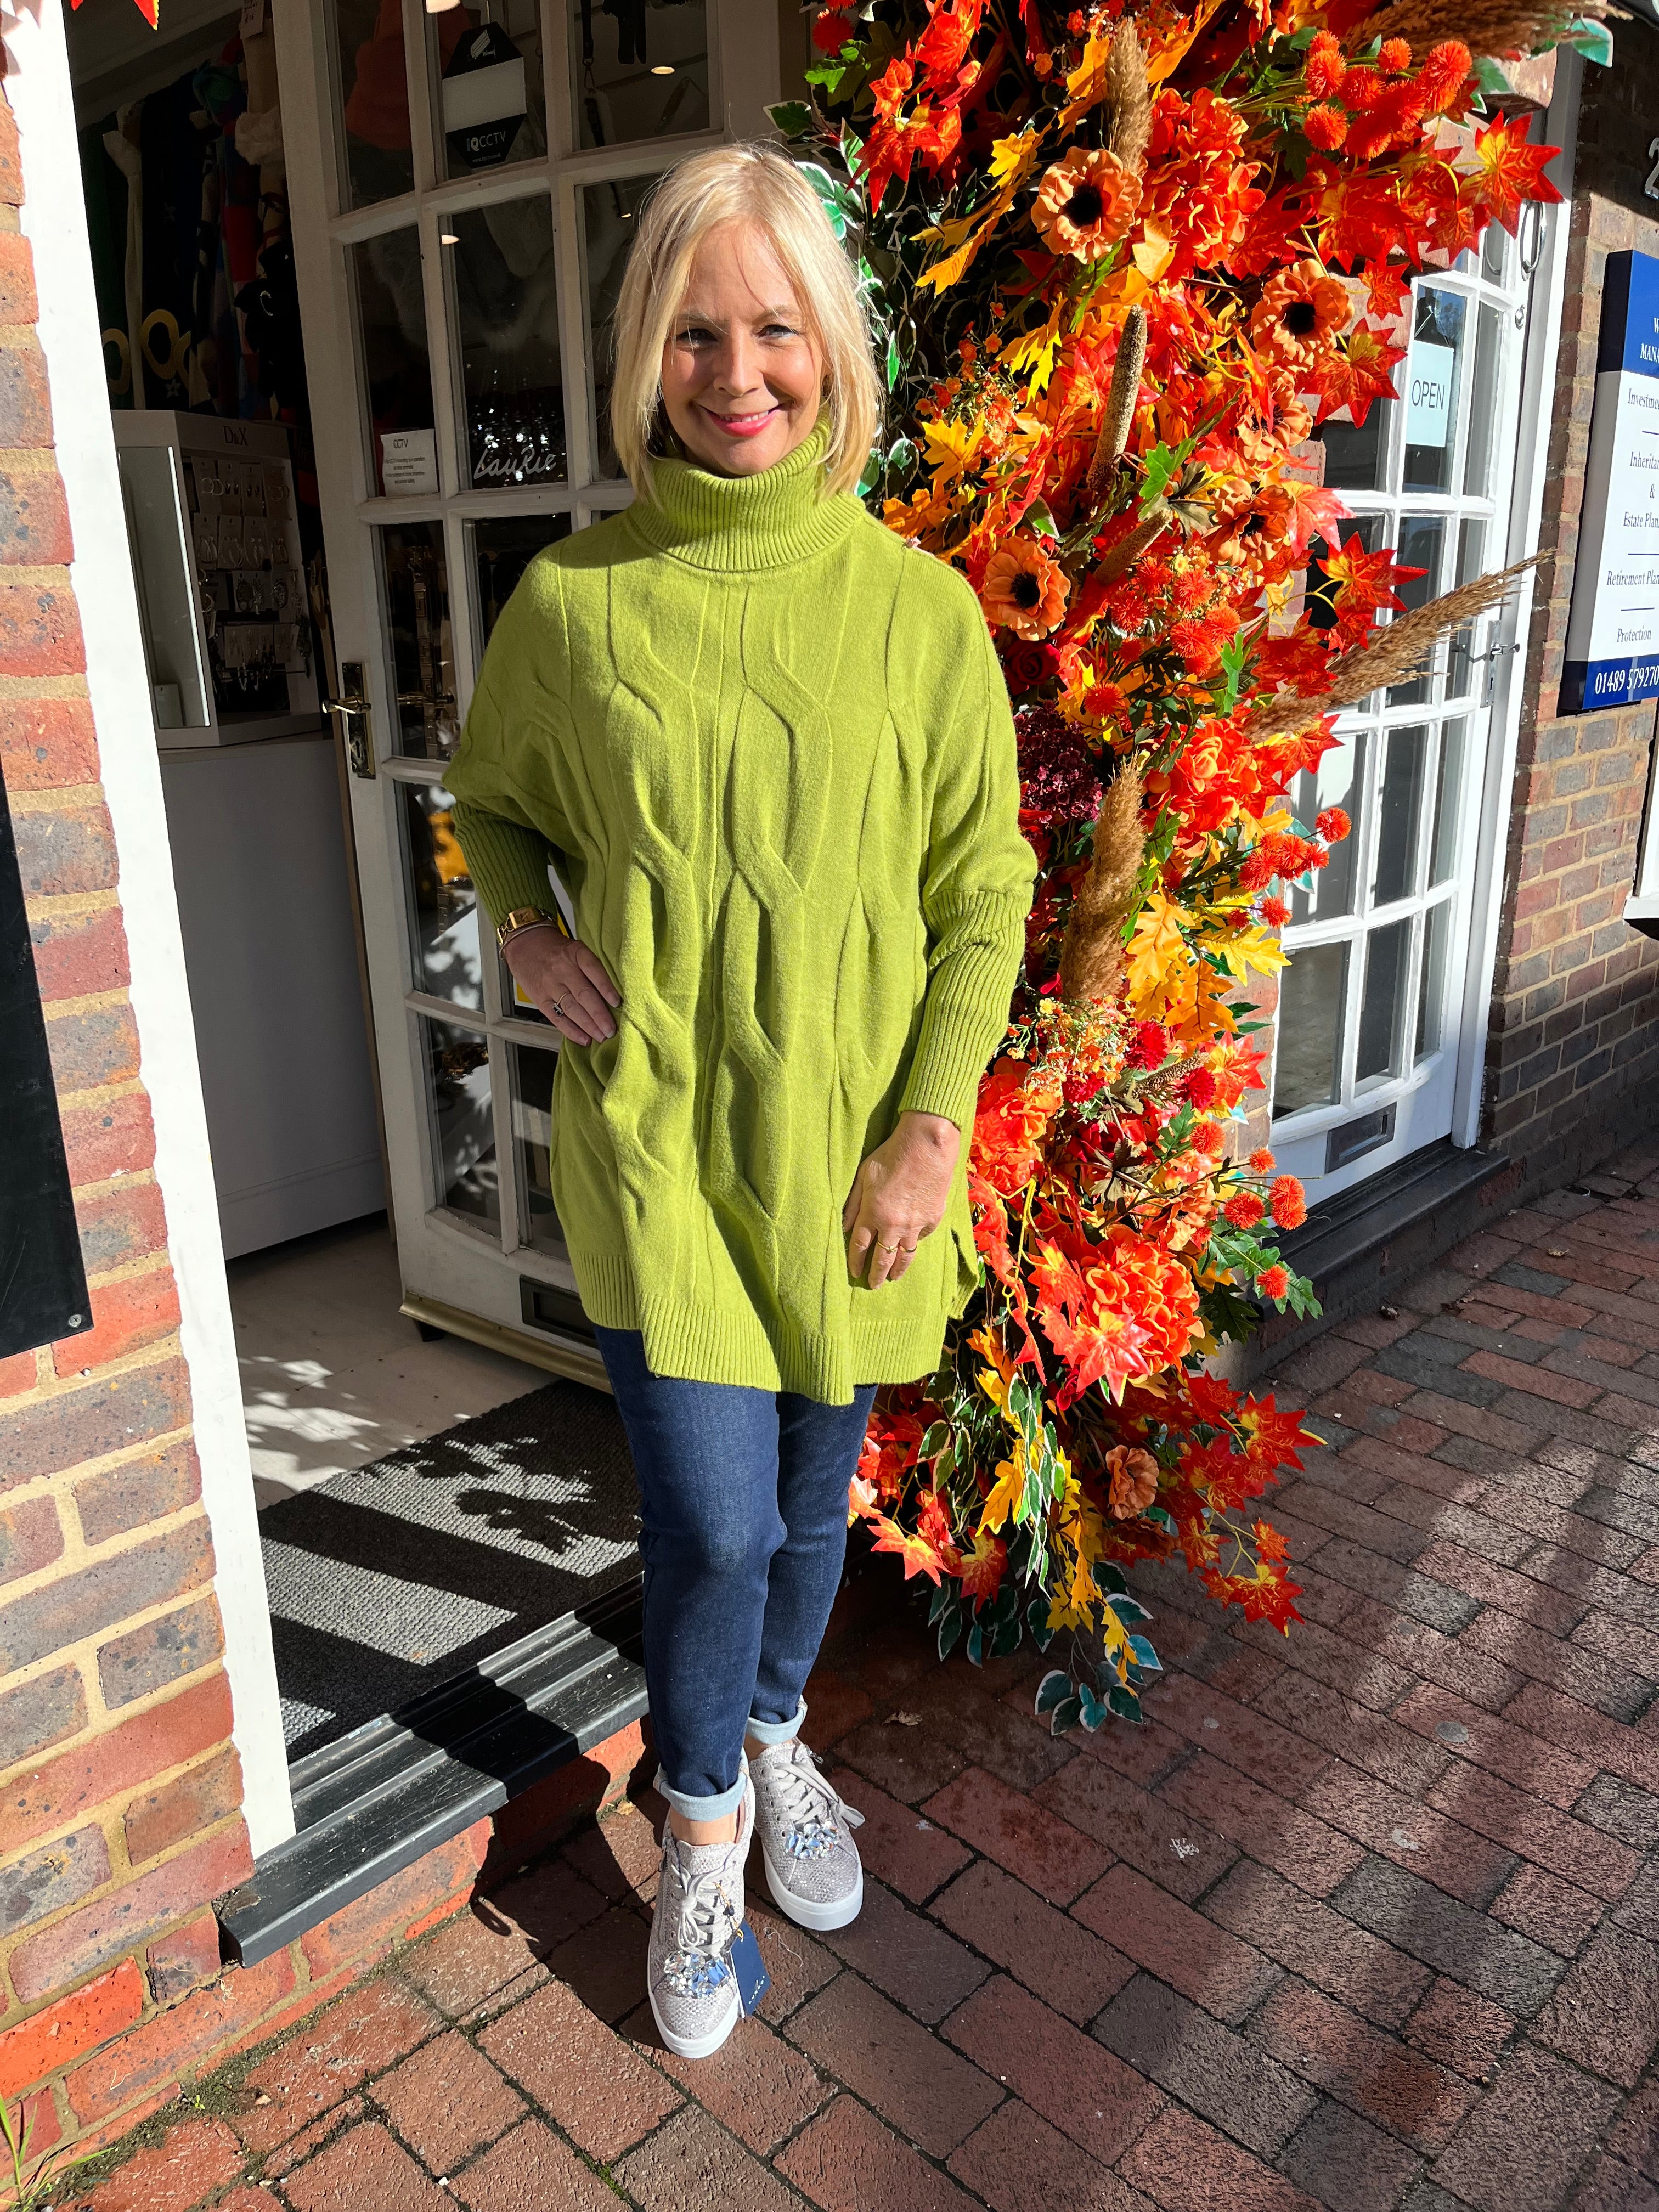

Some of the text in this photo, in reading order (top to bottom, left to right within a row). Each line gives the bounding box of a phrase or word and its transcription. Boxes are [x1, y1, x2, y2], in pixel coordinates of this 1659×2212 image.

[1412, 379, 1446, 410] OPEN
[393, 438, 408, 449] CCTV
[1649, 483, 1656, 499] &
[1623, 511, 1659, 528] Estate Plan
[1606, 570, 1646, 586] Retirement
[1616, 625, 1652, 643] Protection
[1595, 669, 1626, 695] 01489
